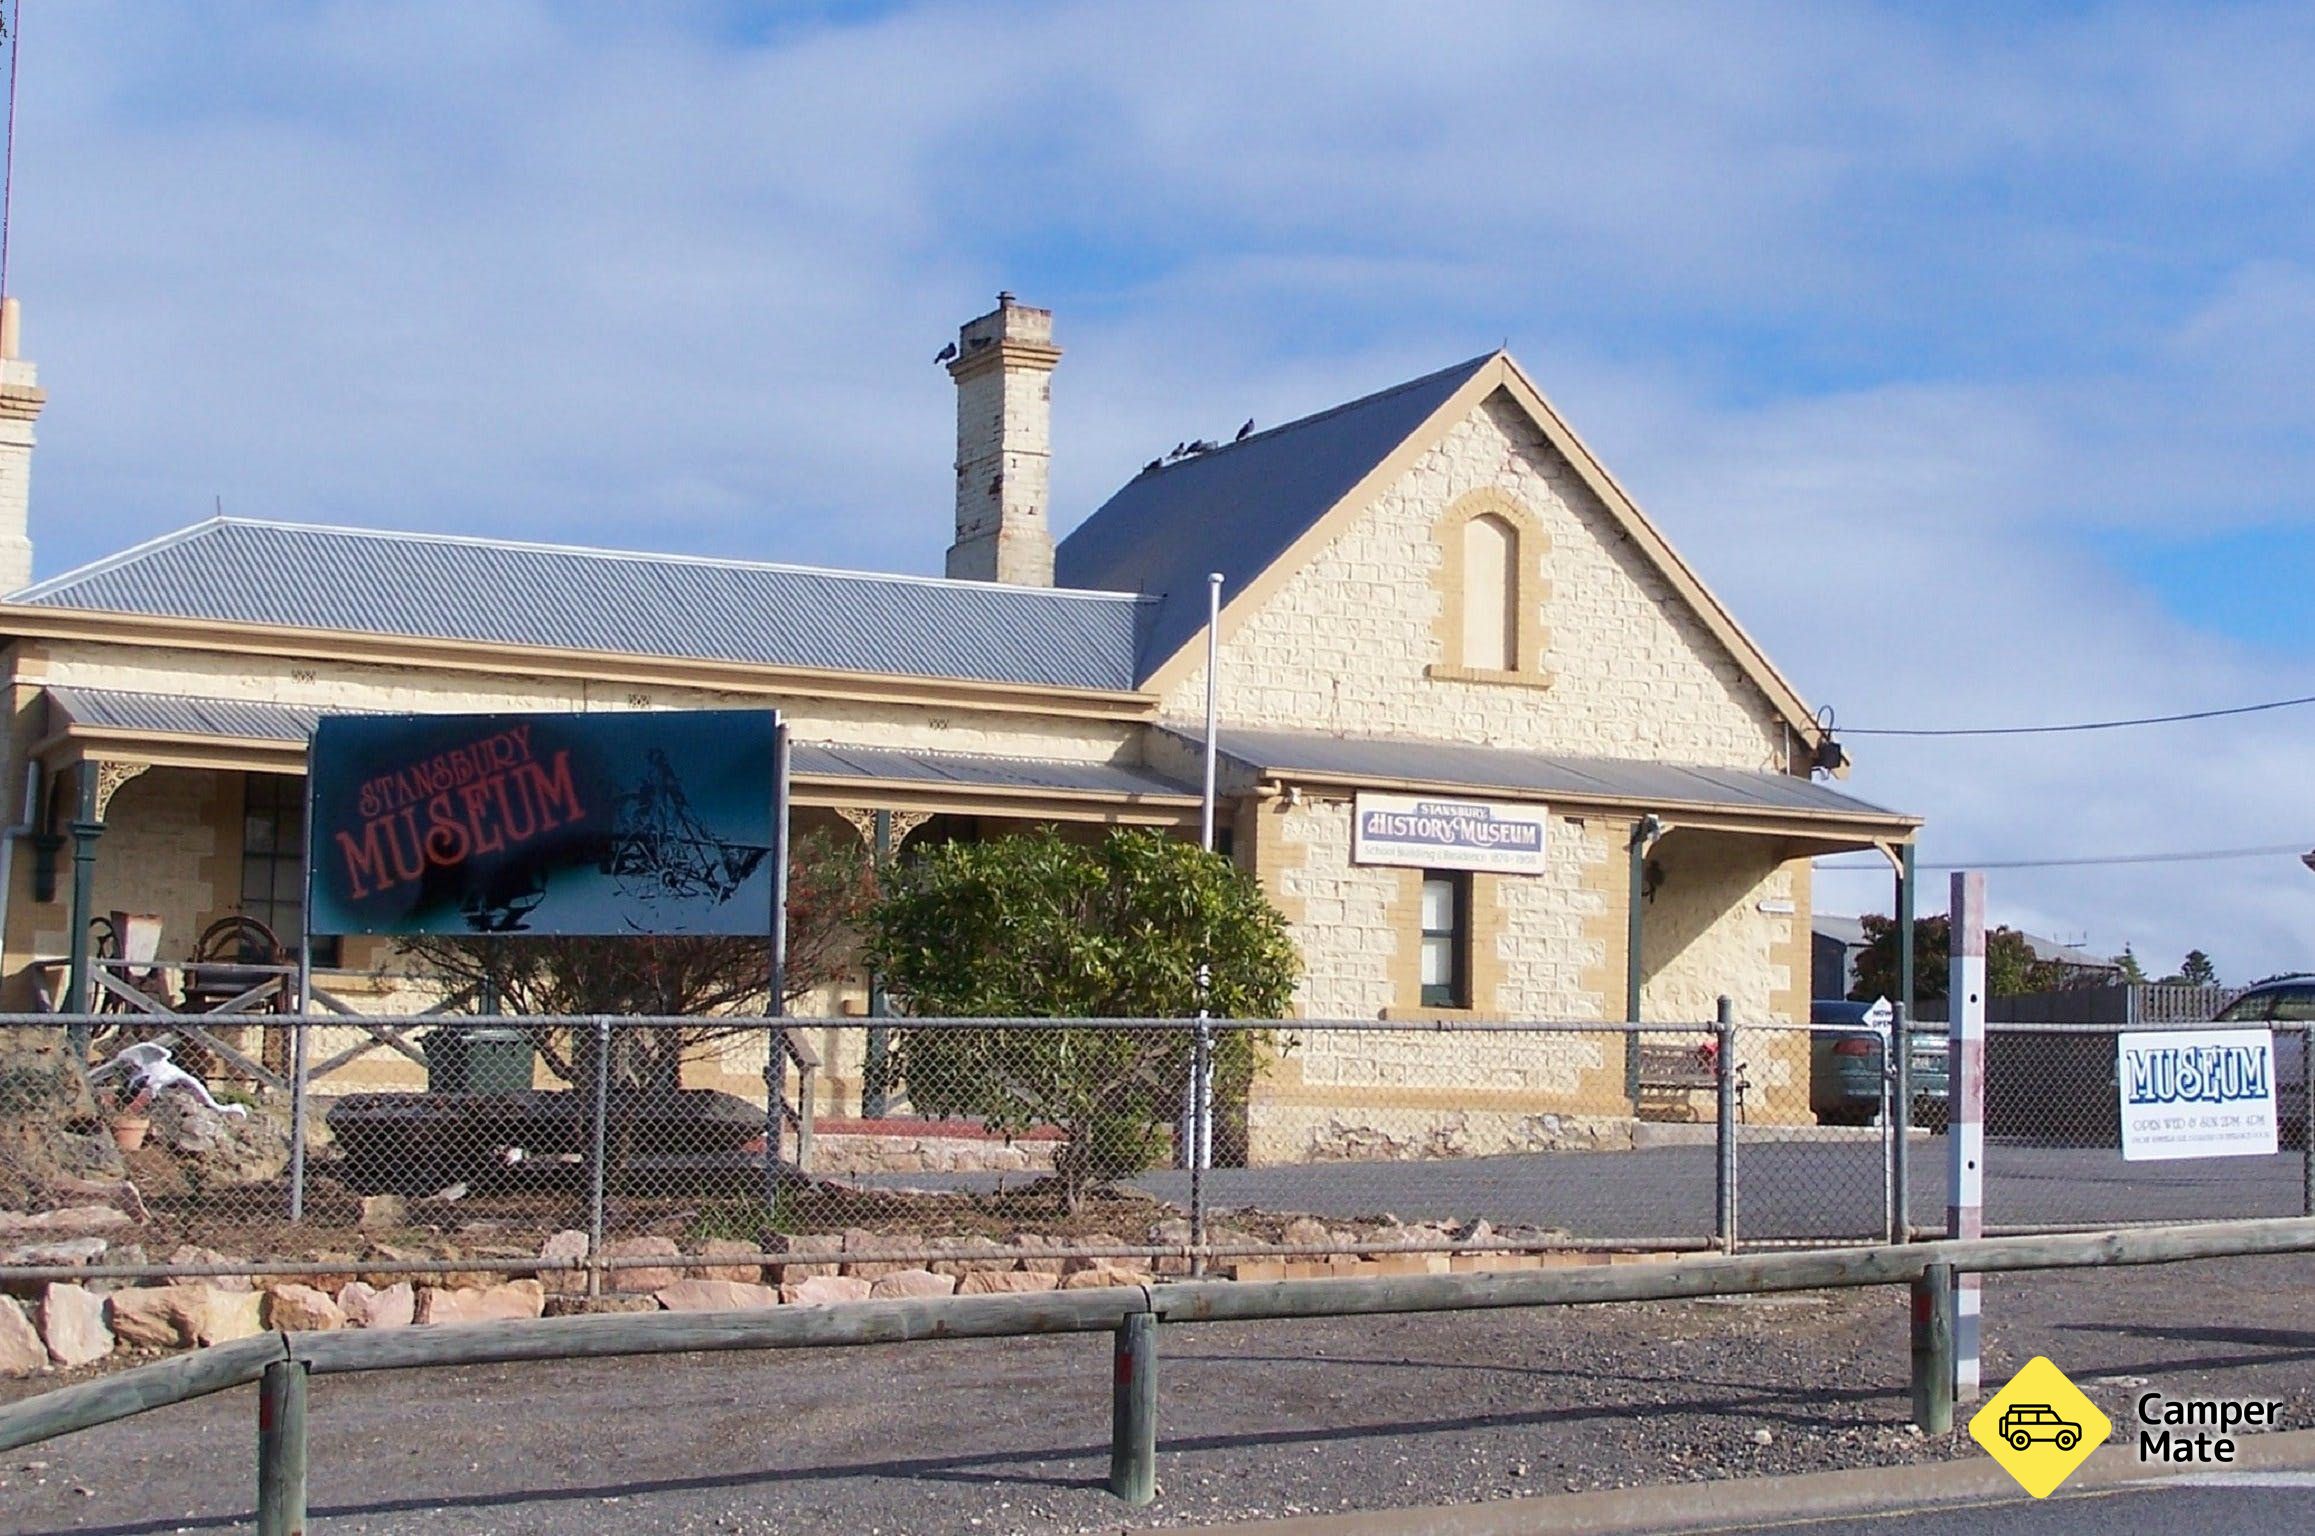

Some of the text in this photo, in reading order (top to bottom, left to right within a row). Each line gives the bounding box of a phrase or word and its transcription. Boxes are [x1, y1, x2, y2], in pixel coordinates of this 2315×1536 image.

[360, 724, 533, 817] STANSBURY
[336, 748, 585, 900] MUSEUM
[1368, 813, 1536, 847] HISTORY MUSEUM
[1420, 804, 1487, 819] STANSBURY
[2127, 1045, 2269, 1104] MUSEUM
